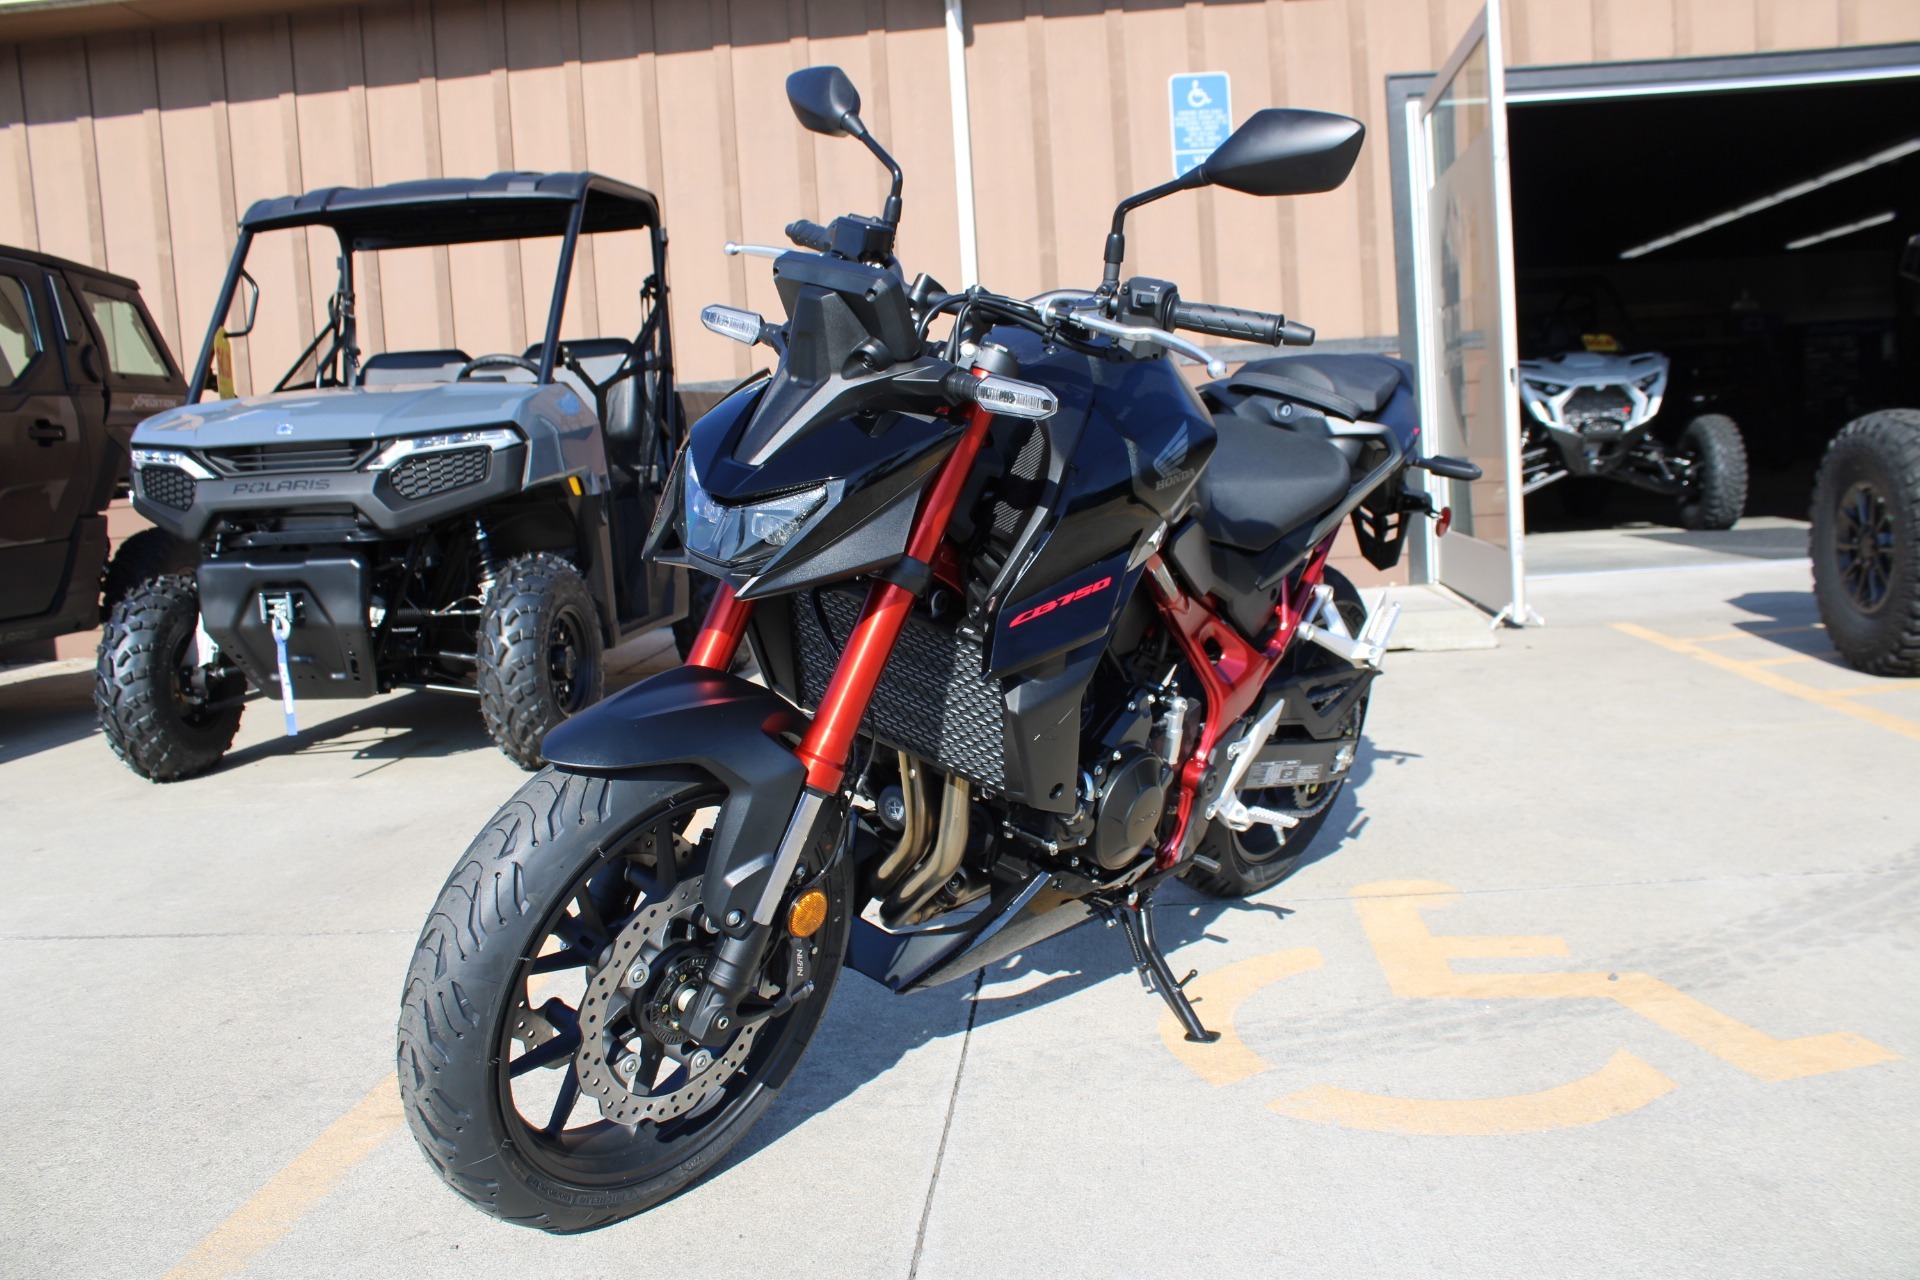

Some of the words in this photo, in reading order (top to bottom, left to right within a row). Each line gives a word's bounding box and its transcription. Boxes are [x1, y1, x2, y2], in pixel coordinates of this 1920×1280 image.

[233, 479, 331, 494] POLARIS
[1155, 467, 1196, 491] HONDA
[1009, 577, 1112, 628] CB750
